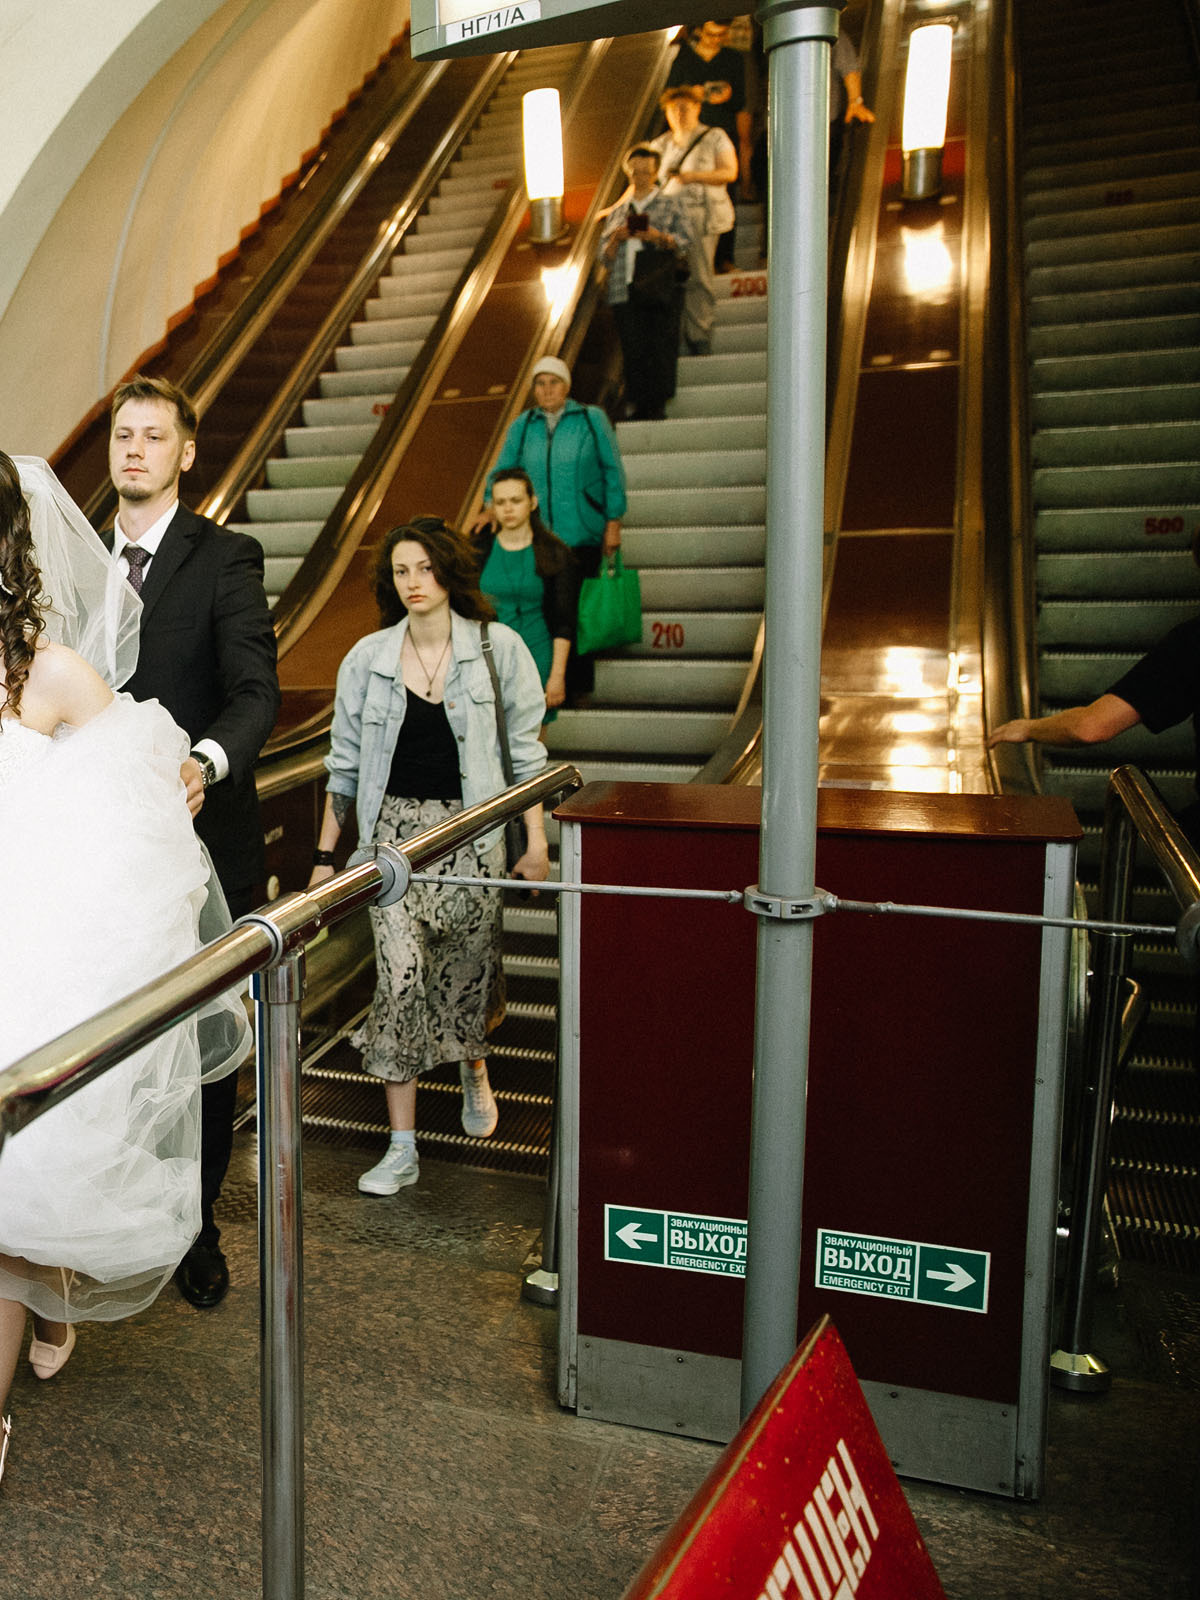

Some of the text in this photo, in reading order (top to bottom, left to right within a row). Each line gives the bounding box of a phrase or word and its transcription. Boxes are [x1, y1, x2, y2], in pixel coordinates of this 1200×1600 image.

[731, 276, 767, 298] 200
[652, 621, 685, 649] 210
[670, 1218, 748, 1235] ЭВАКУАЦИОННЫ
[670, 1229, 748, 1259] ВЫХОД
[824, 1236, 913, 1257] ЭВАКУАЦИОННЫЙ
[670, 1256, 727, 1271] EMERGENCY
[823, 1247, 911, 1281] ВЫХОД
[822, 1275, 910, 1296] EMERGENCY EXIT
